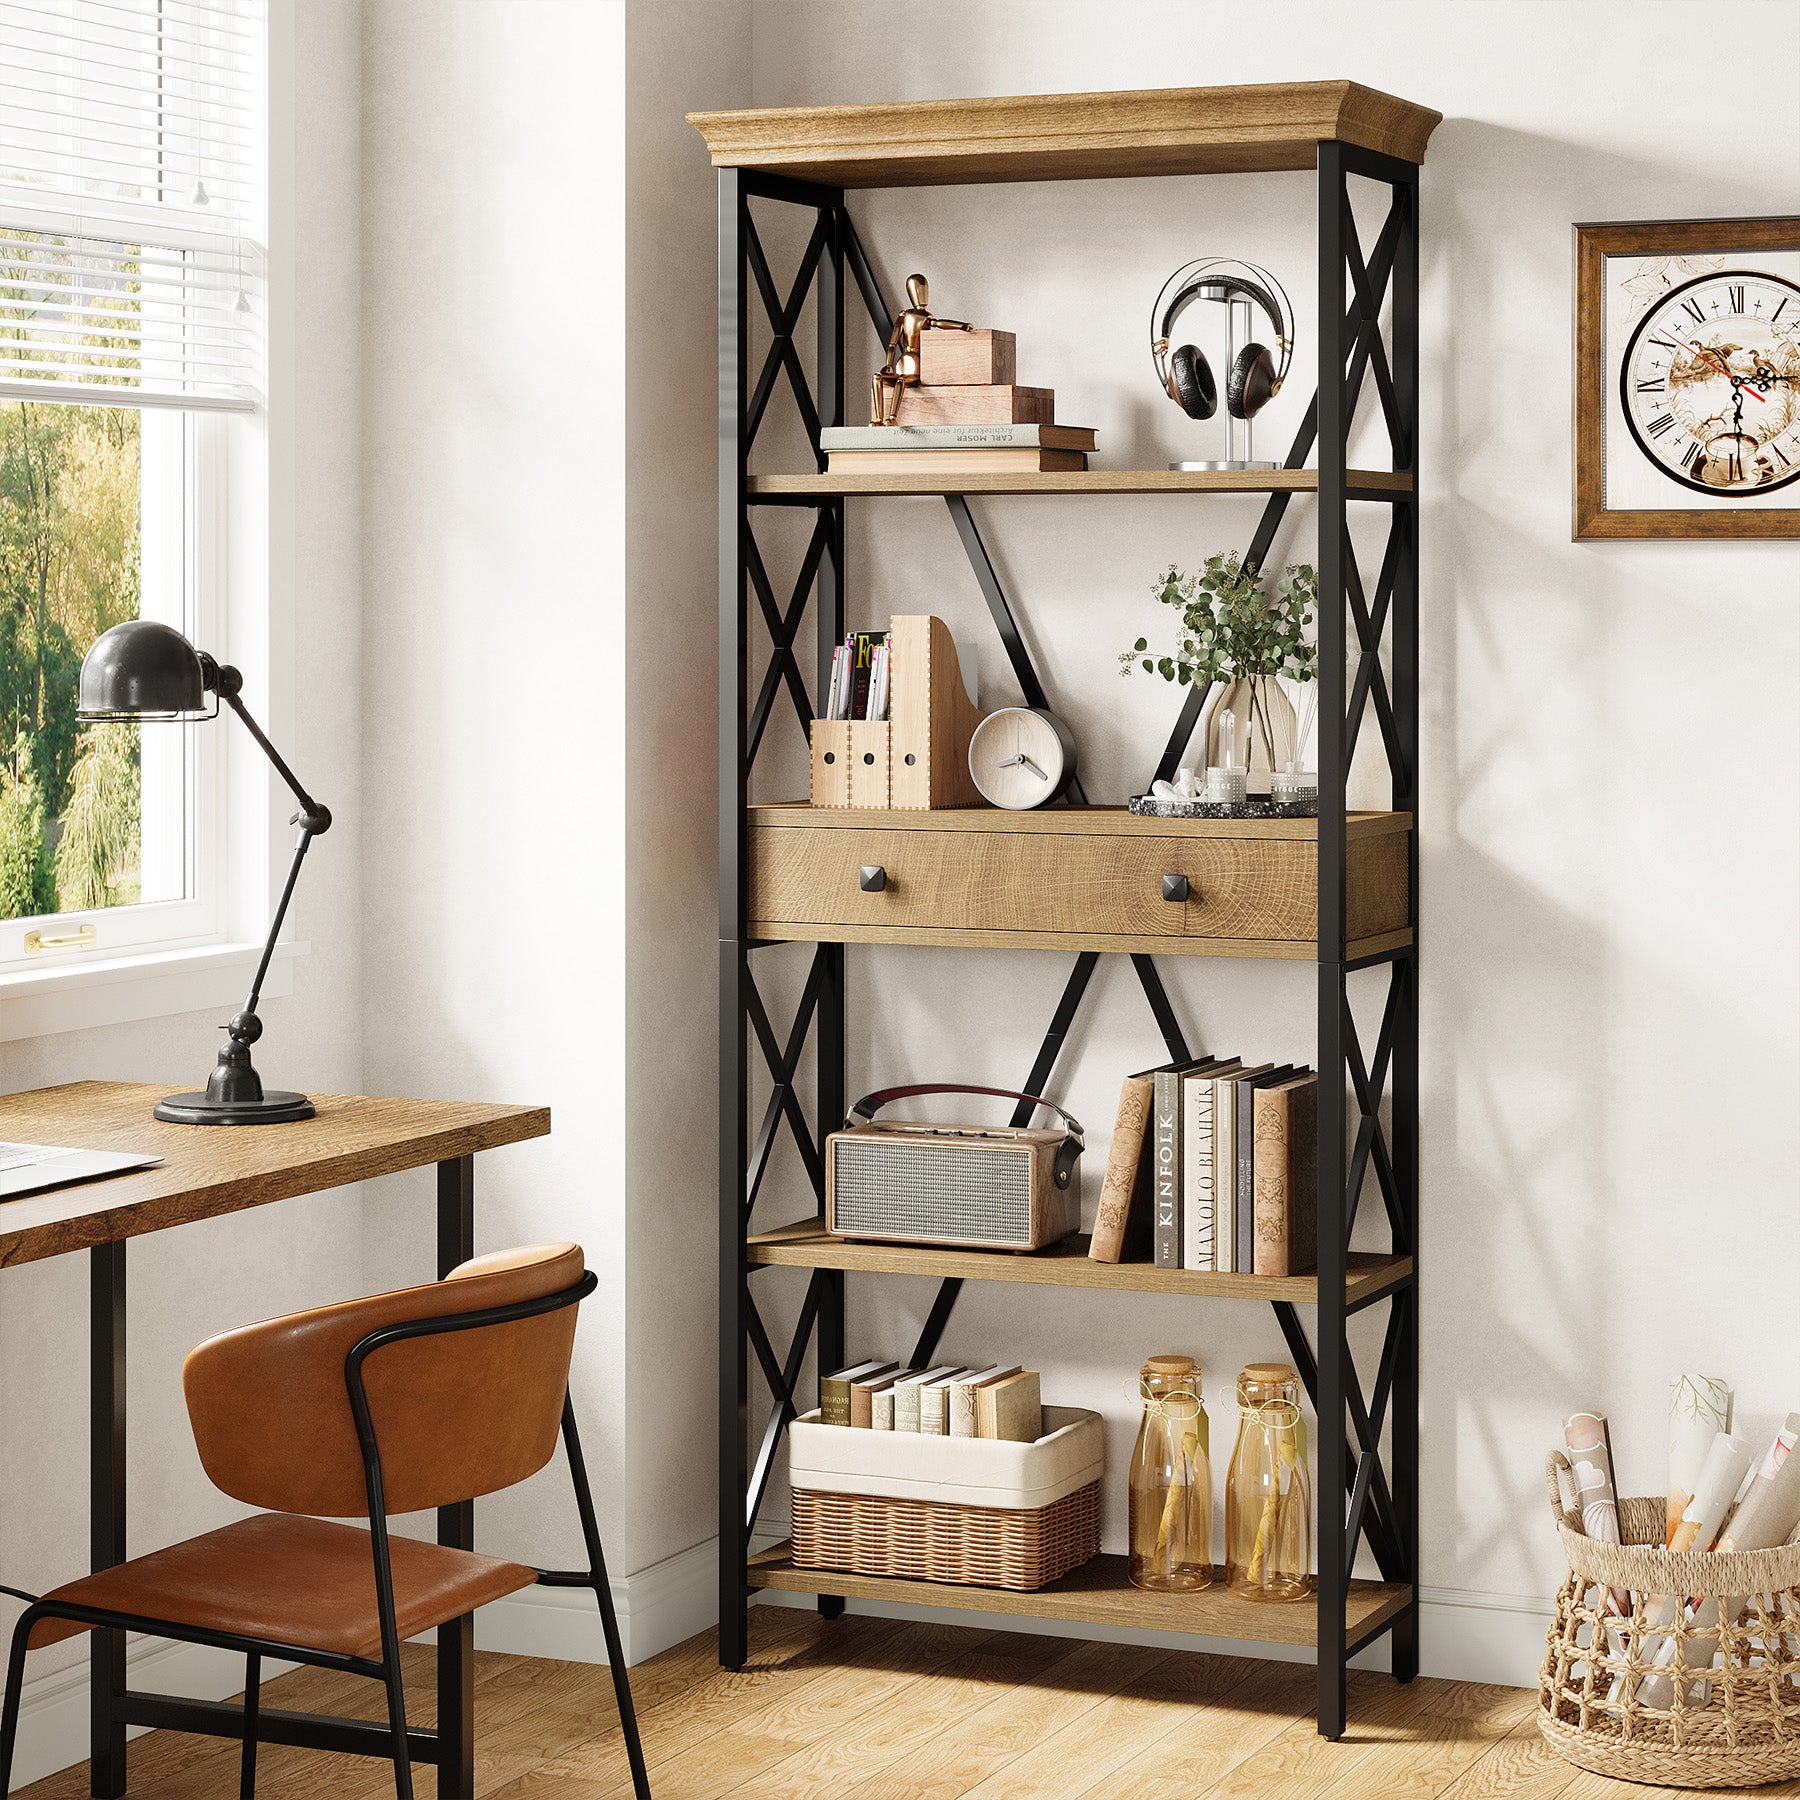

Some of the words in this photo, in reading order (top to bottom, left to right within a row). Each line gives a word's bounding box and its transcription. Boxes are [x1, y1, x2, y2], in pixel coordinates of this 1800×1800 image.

[1728, 286, 1745, 314] XII
[991, 434, 1013, 442] CARL
[1195, 1086, 1213, 1168] BLAHNÍK
[1159, 1114, 1173, 1227] KINFOLK
[1198, 1175, 1215, 1264] MANOLO
